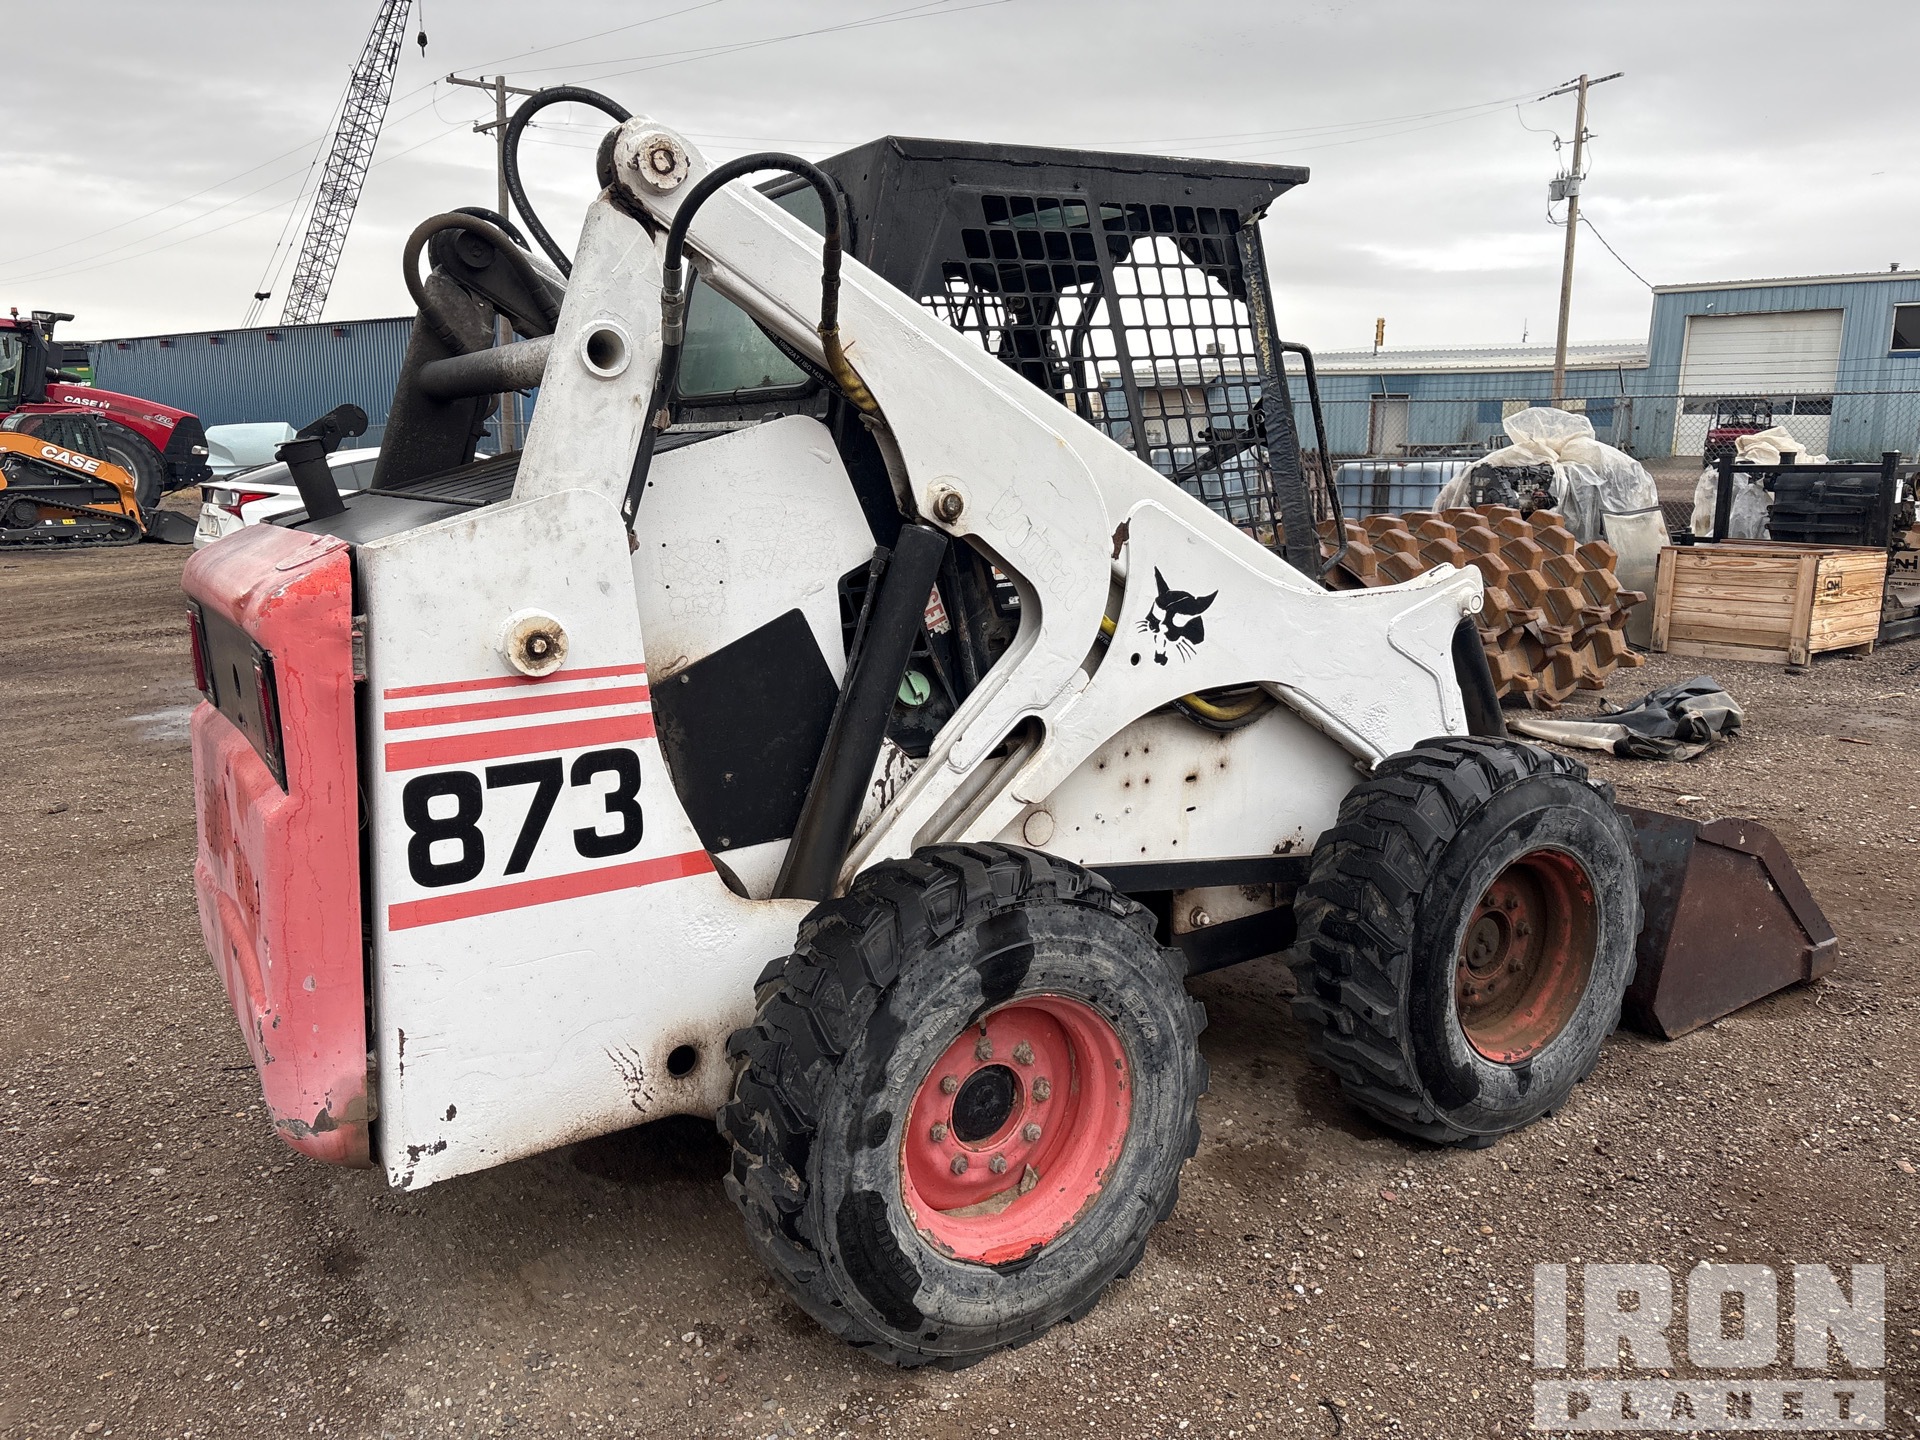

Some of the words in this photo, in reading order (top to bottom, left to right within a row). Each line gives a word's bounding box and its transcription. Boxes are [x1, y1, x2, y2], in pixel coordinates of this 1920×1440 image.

[801, 361, 812, 371] ISO
[64, 396, 98, 407] CASE
[41, 445, 100, 473] CASE
[402, 747, 644, 888] 873
